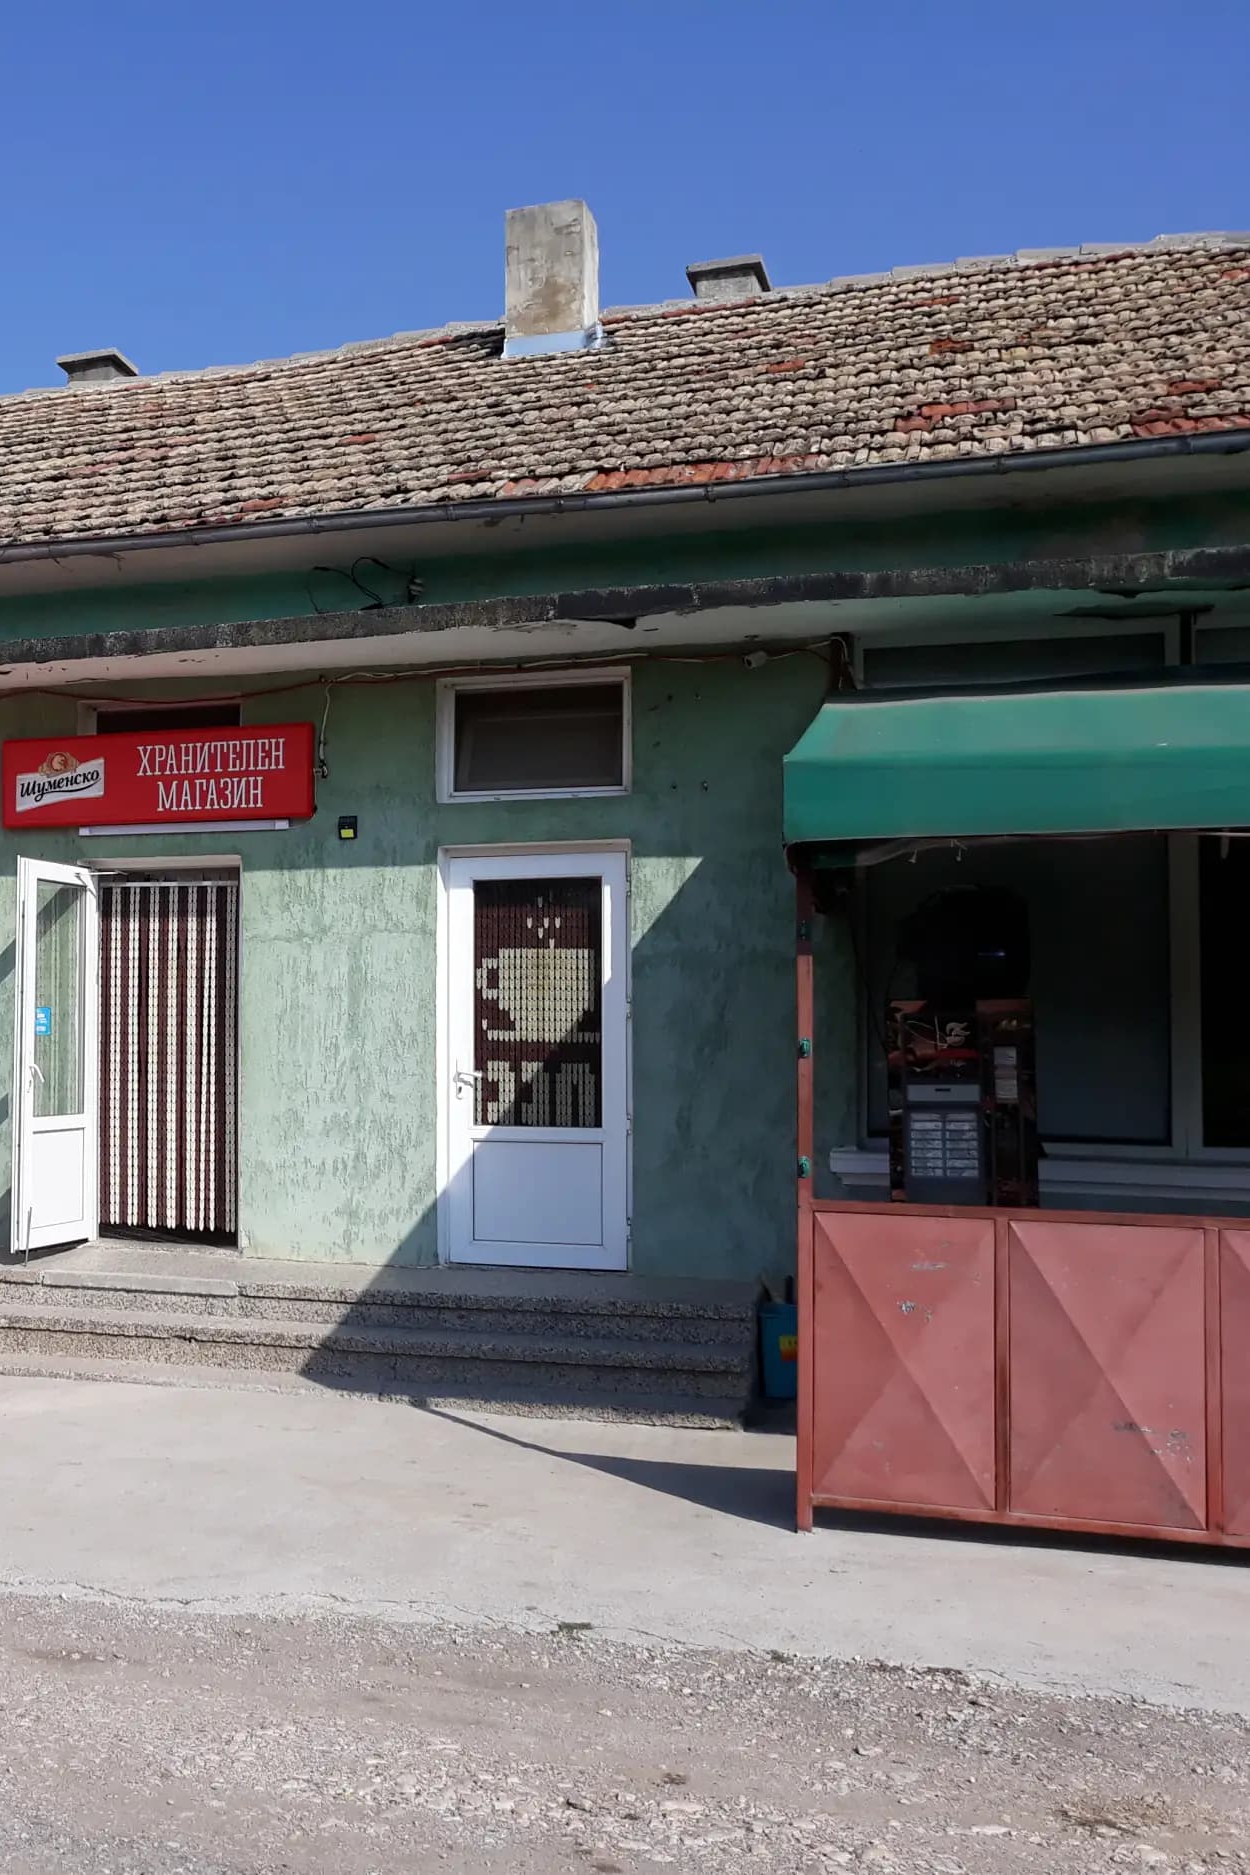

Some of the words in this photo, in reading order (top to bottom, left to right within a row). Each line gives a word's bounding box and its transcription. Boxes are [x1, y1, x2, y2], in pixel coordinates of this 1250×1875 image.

[137, 738, 286, 776] ХРАНИТЕЛЕН
[20, 769, 101, 803] Шуменско
[157, 776, 264, 812] МАГАЗИН
